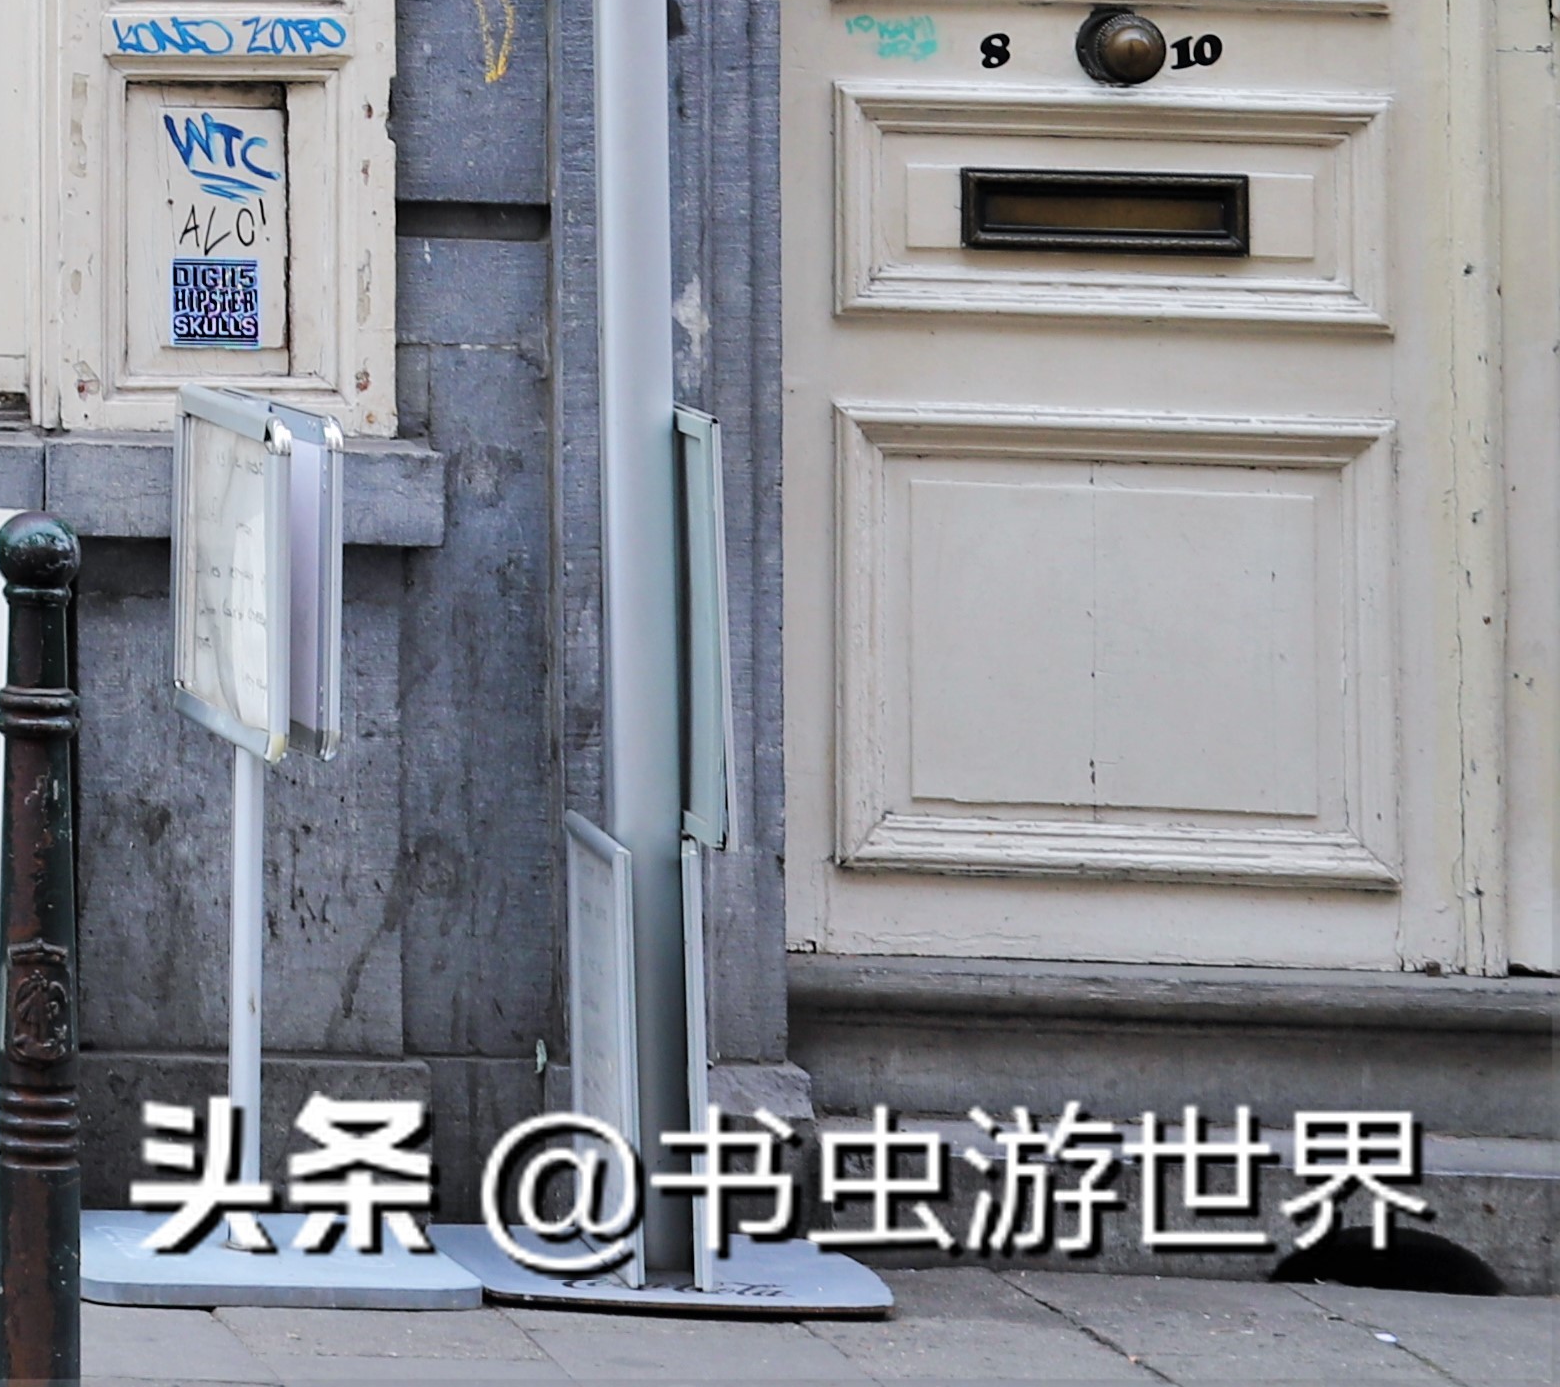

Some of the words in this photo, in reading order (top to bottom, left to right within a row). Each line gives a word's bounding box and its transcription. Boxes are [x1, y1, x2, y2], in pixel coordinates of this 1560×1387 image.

[980, 33, 1010, 68] 8
[1170, 33, 1221, 68] 10
[163, 112, 281, 180] WTC
[174, 317, 258, 336] SKULLS
